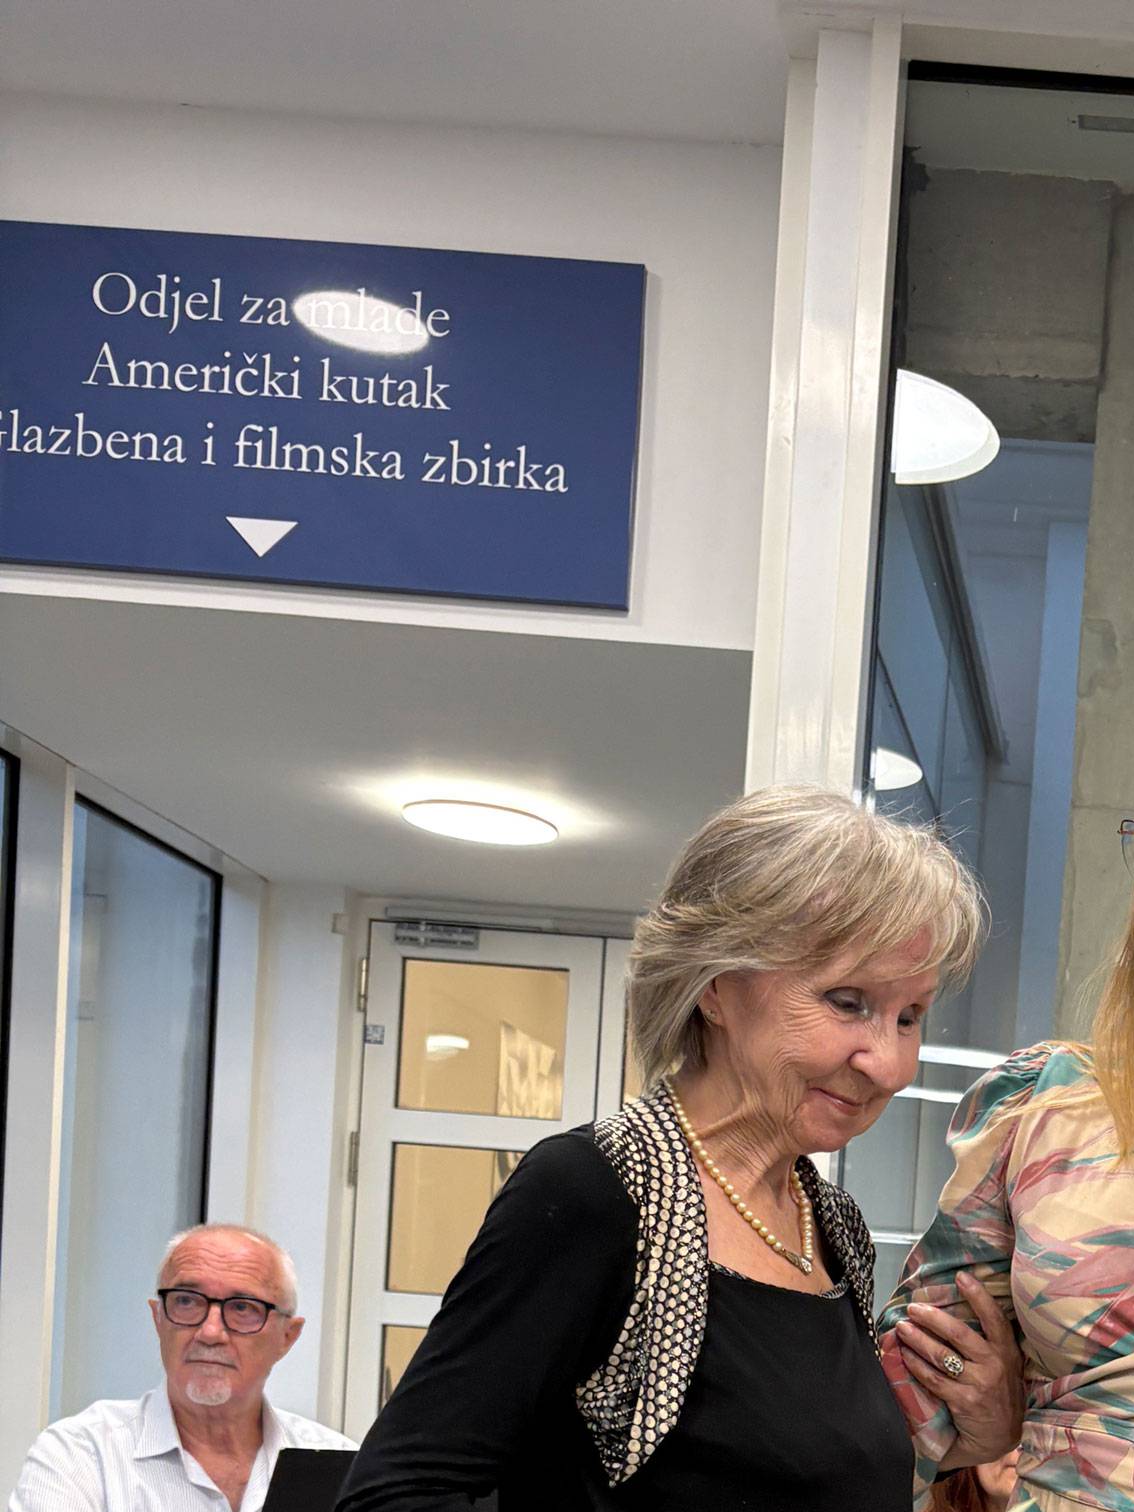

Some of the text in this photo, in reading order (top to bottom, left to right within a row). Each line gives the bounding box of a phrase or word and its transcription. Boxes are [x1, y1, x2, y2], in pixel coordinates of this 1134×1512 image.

[92, 272, 451, 338] Odjel za mlade
[82, 341, 451, 410] Američki kutak
[0, 408, 569, 493] lazbena i filmska zbirka
